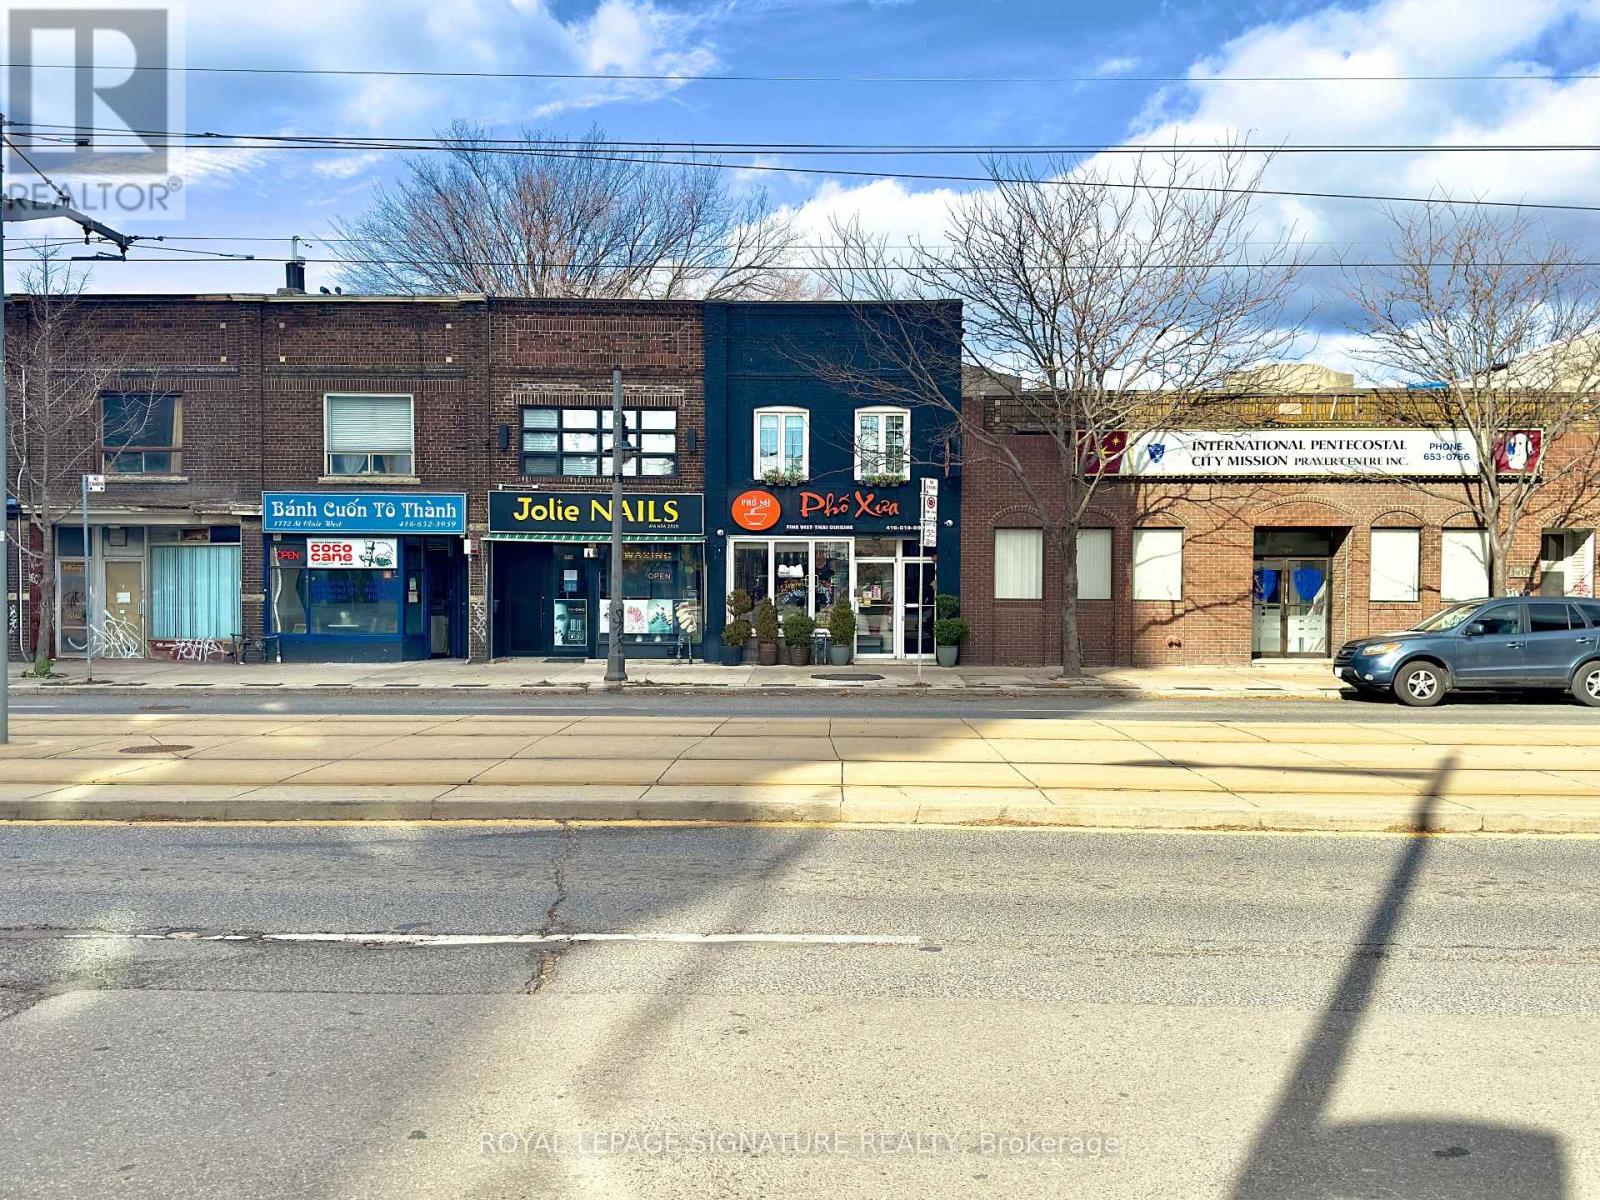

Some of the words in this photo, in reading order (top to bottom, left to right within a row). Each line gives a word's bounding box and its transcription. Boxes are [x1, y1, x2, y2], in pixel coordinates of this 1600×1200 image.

[1192, 440, 1305, 451] INTERNATIONAL
[1311, 439, 1407, 450] PENTECOSTAL
[1429, 443, 1463, 451] PHONE
[1191, 456, 1224, 466] CITY
[1228, 455, 1288, 466] MISSION
[1423, 453, 1471, 461] 653-0766
[271, 499, 317, 517] Bánh
[323, 498, 369, 518] Cuốn
[372, 502, 397, 518] Tô
[400, 500, 457, 518] Thành
[513, 497, 580, 522] Jolie
[591, 499, 679, 522] NAILS
[310, 544, 353, 552] coco
[277, 551, 300, 560] OPEN
[310, 553, 353, 562] cane
[648, 572, 671, 580] OPEN
